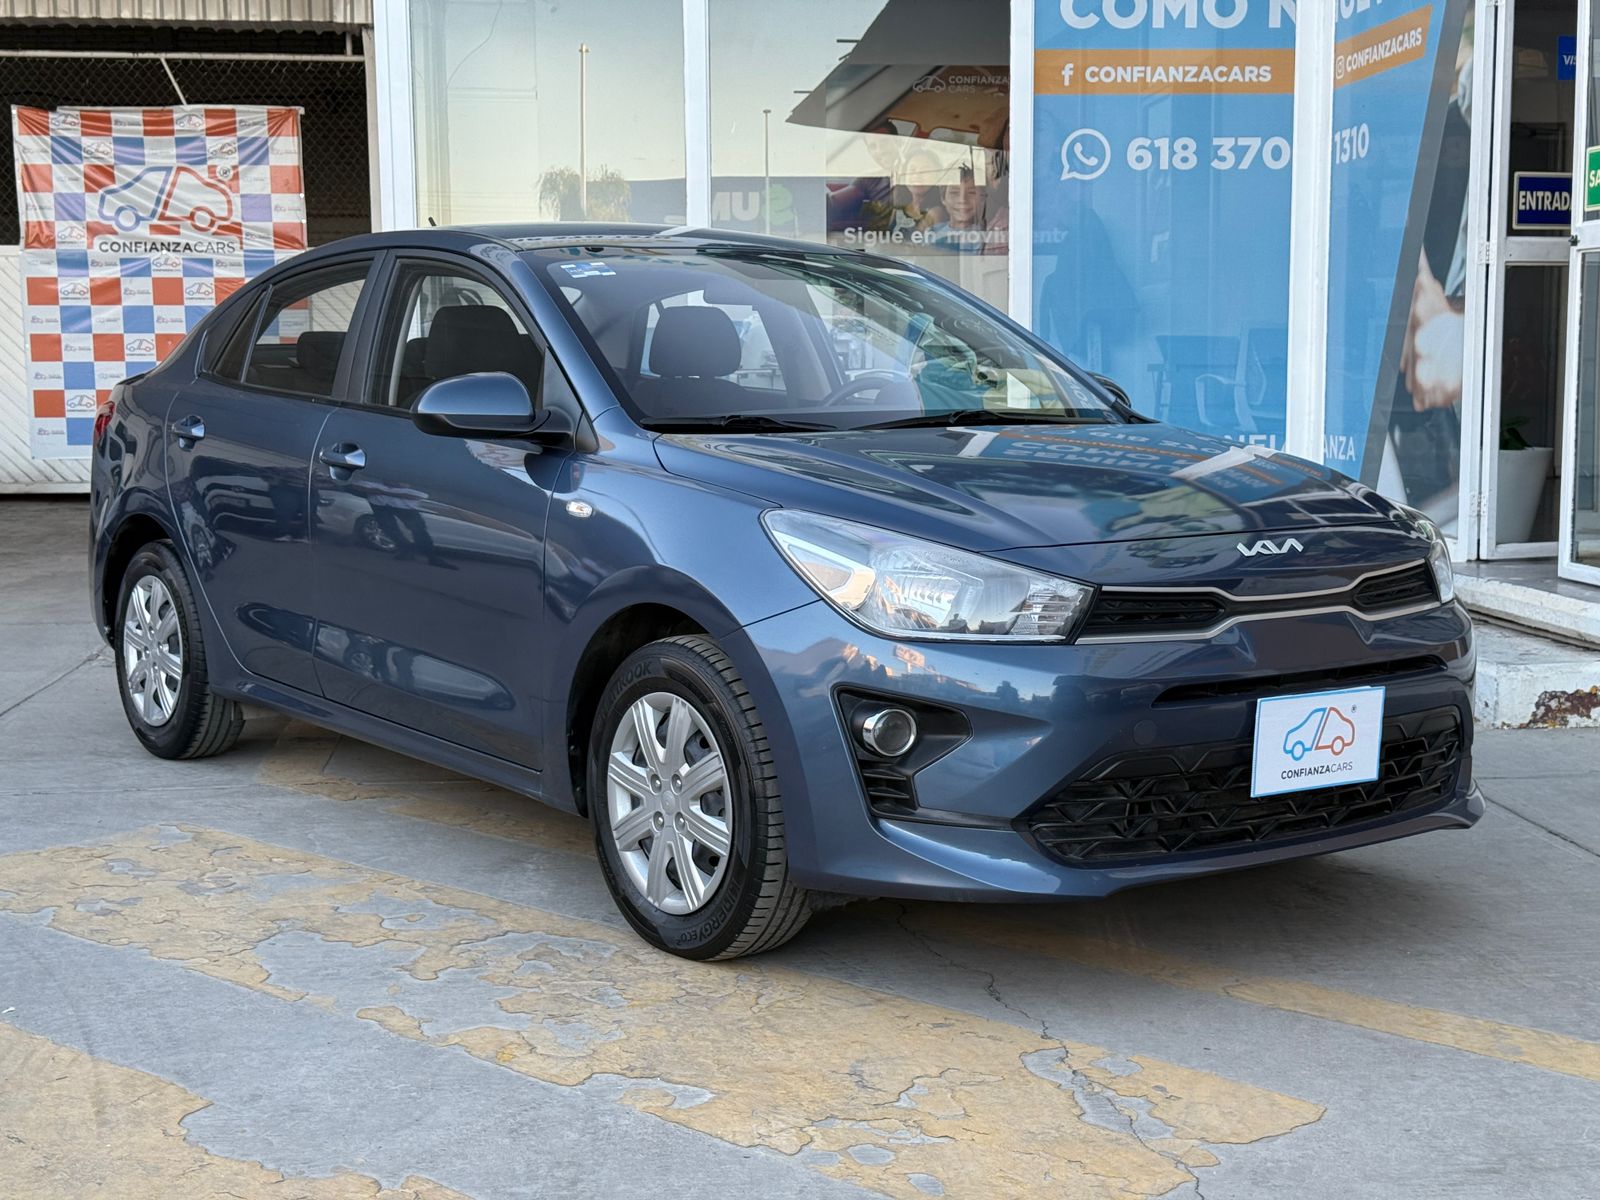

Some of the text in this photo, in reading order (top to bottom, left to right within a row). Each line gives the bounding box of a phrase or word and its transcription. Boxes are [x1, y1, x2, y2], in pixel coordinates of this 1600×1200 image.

[1060, 0, 1248, 29] COMO
[1346, 27, 1422, 72] CONFIANZACARS
[949, 75, 1010, 84] CONFIANZA
[1084, 65, 1272, 83] CONFIANZACARS
[949, 85, 976, 94] CARS
[1126, 136, 1291, 171] 618 370
[1334, 123, 1369, 164] 1310
[1519, 190, 1571, 211] ENTRAD
[99, 241, 236, 254] CONFIANZACARS
[843, 227, 902, 248] Sigue
[1237, 538, 1304, 557] KIA
[1281, 761, 1353, 779] CONFIANZACARS
